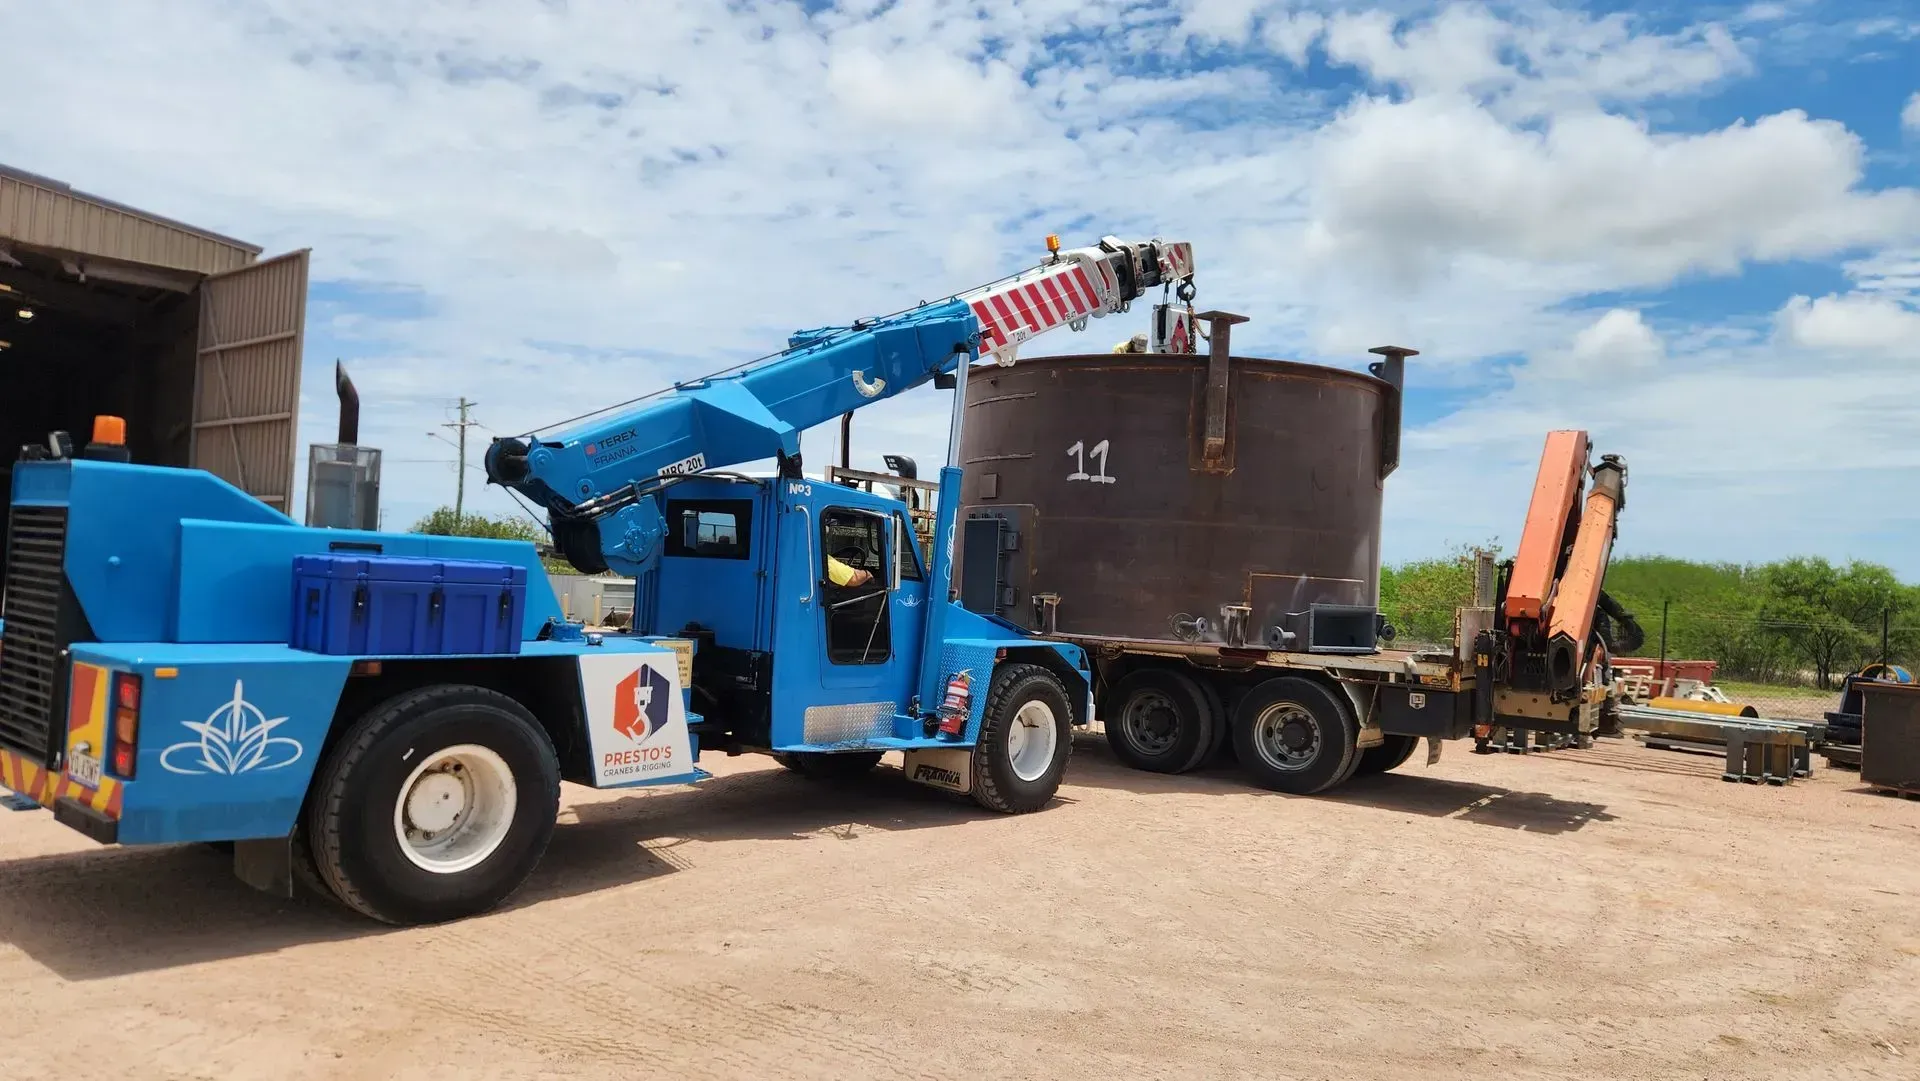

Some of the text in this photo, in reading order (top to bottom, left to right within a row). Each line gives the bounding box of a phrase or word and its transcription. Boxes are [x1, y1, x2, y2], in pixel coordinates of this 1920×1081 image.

[597, 428, 638, 449] TEREX
[593, 445, 638, 467] FRANNA
[686, 456, 702, 471] 20t
[1066, 439, 1117, 484] 11
[604, 745, 672, 767] PRESTO'S
[603, 761, 671, 777] CRANES & RIGGING
[913, 763, 962, 785] FRANNA
